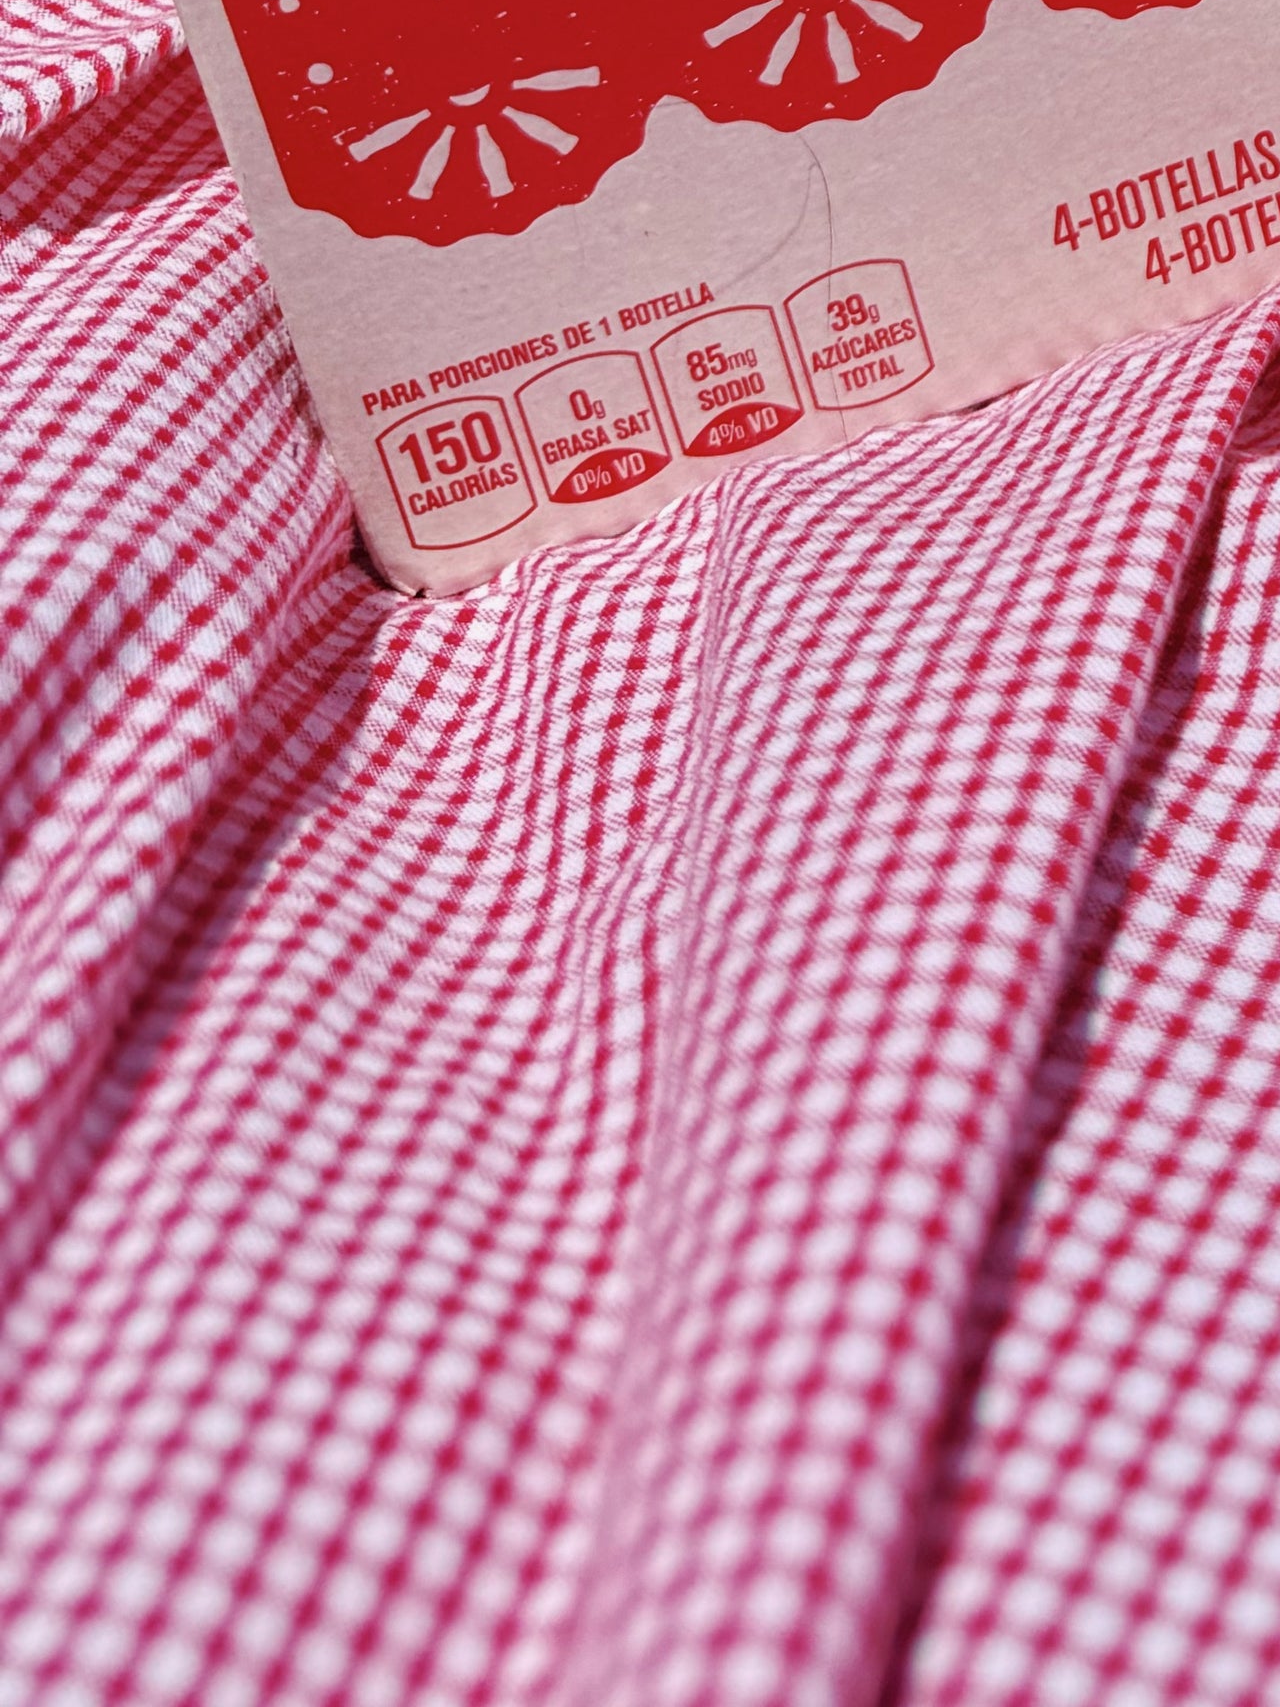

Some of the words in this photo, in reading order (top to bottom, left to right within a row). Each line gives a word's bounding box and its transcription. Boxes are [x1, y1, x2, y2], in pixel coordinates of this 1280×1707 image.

[1052, 129, 1280, 251] 4-BOTELLAS
[826, 293, 881, 332] 39g
[362, 378, 426, 416] PARA
[428, 333, 559, 394] PORCIONES
[562, 321, 596, 350] DE
[598, 316, 613, 337] 1
[618, 282, 715, 332] BOTELLA
[686, 343, 759, 383] 85mg
[811, 318, 917, 373] AZÚCARES
[697, 371, 766, 412] SODIO
[838, 355, 905, 391] TOTAL
[569, 389, 607, 421] 0g
[708, 420, 746, 448] 4%
[746, 406, 779, 434] VD
[398, 410, 502, 484] 150
[541, 425, 612, 465] GRASA
[613, 409, 651, 441] SAT
[408, 461, 519, 516] CALORÍAS
[571, 464, 613, 496] 0%
[613, 452, 647, 480] VD
